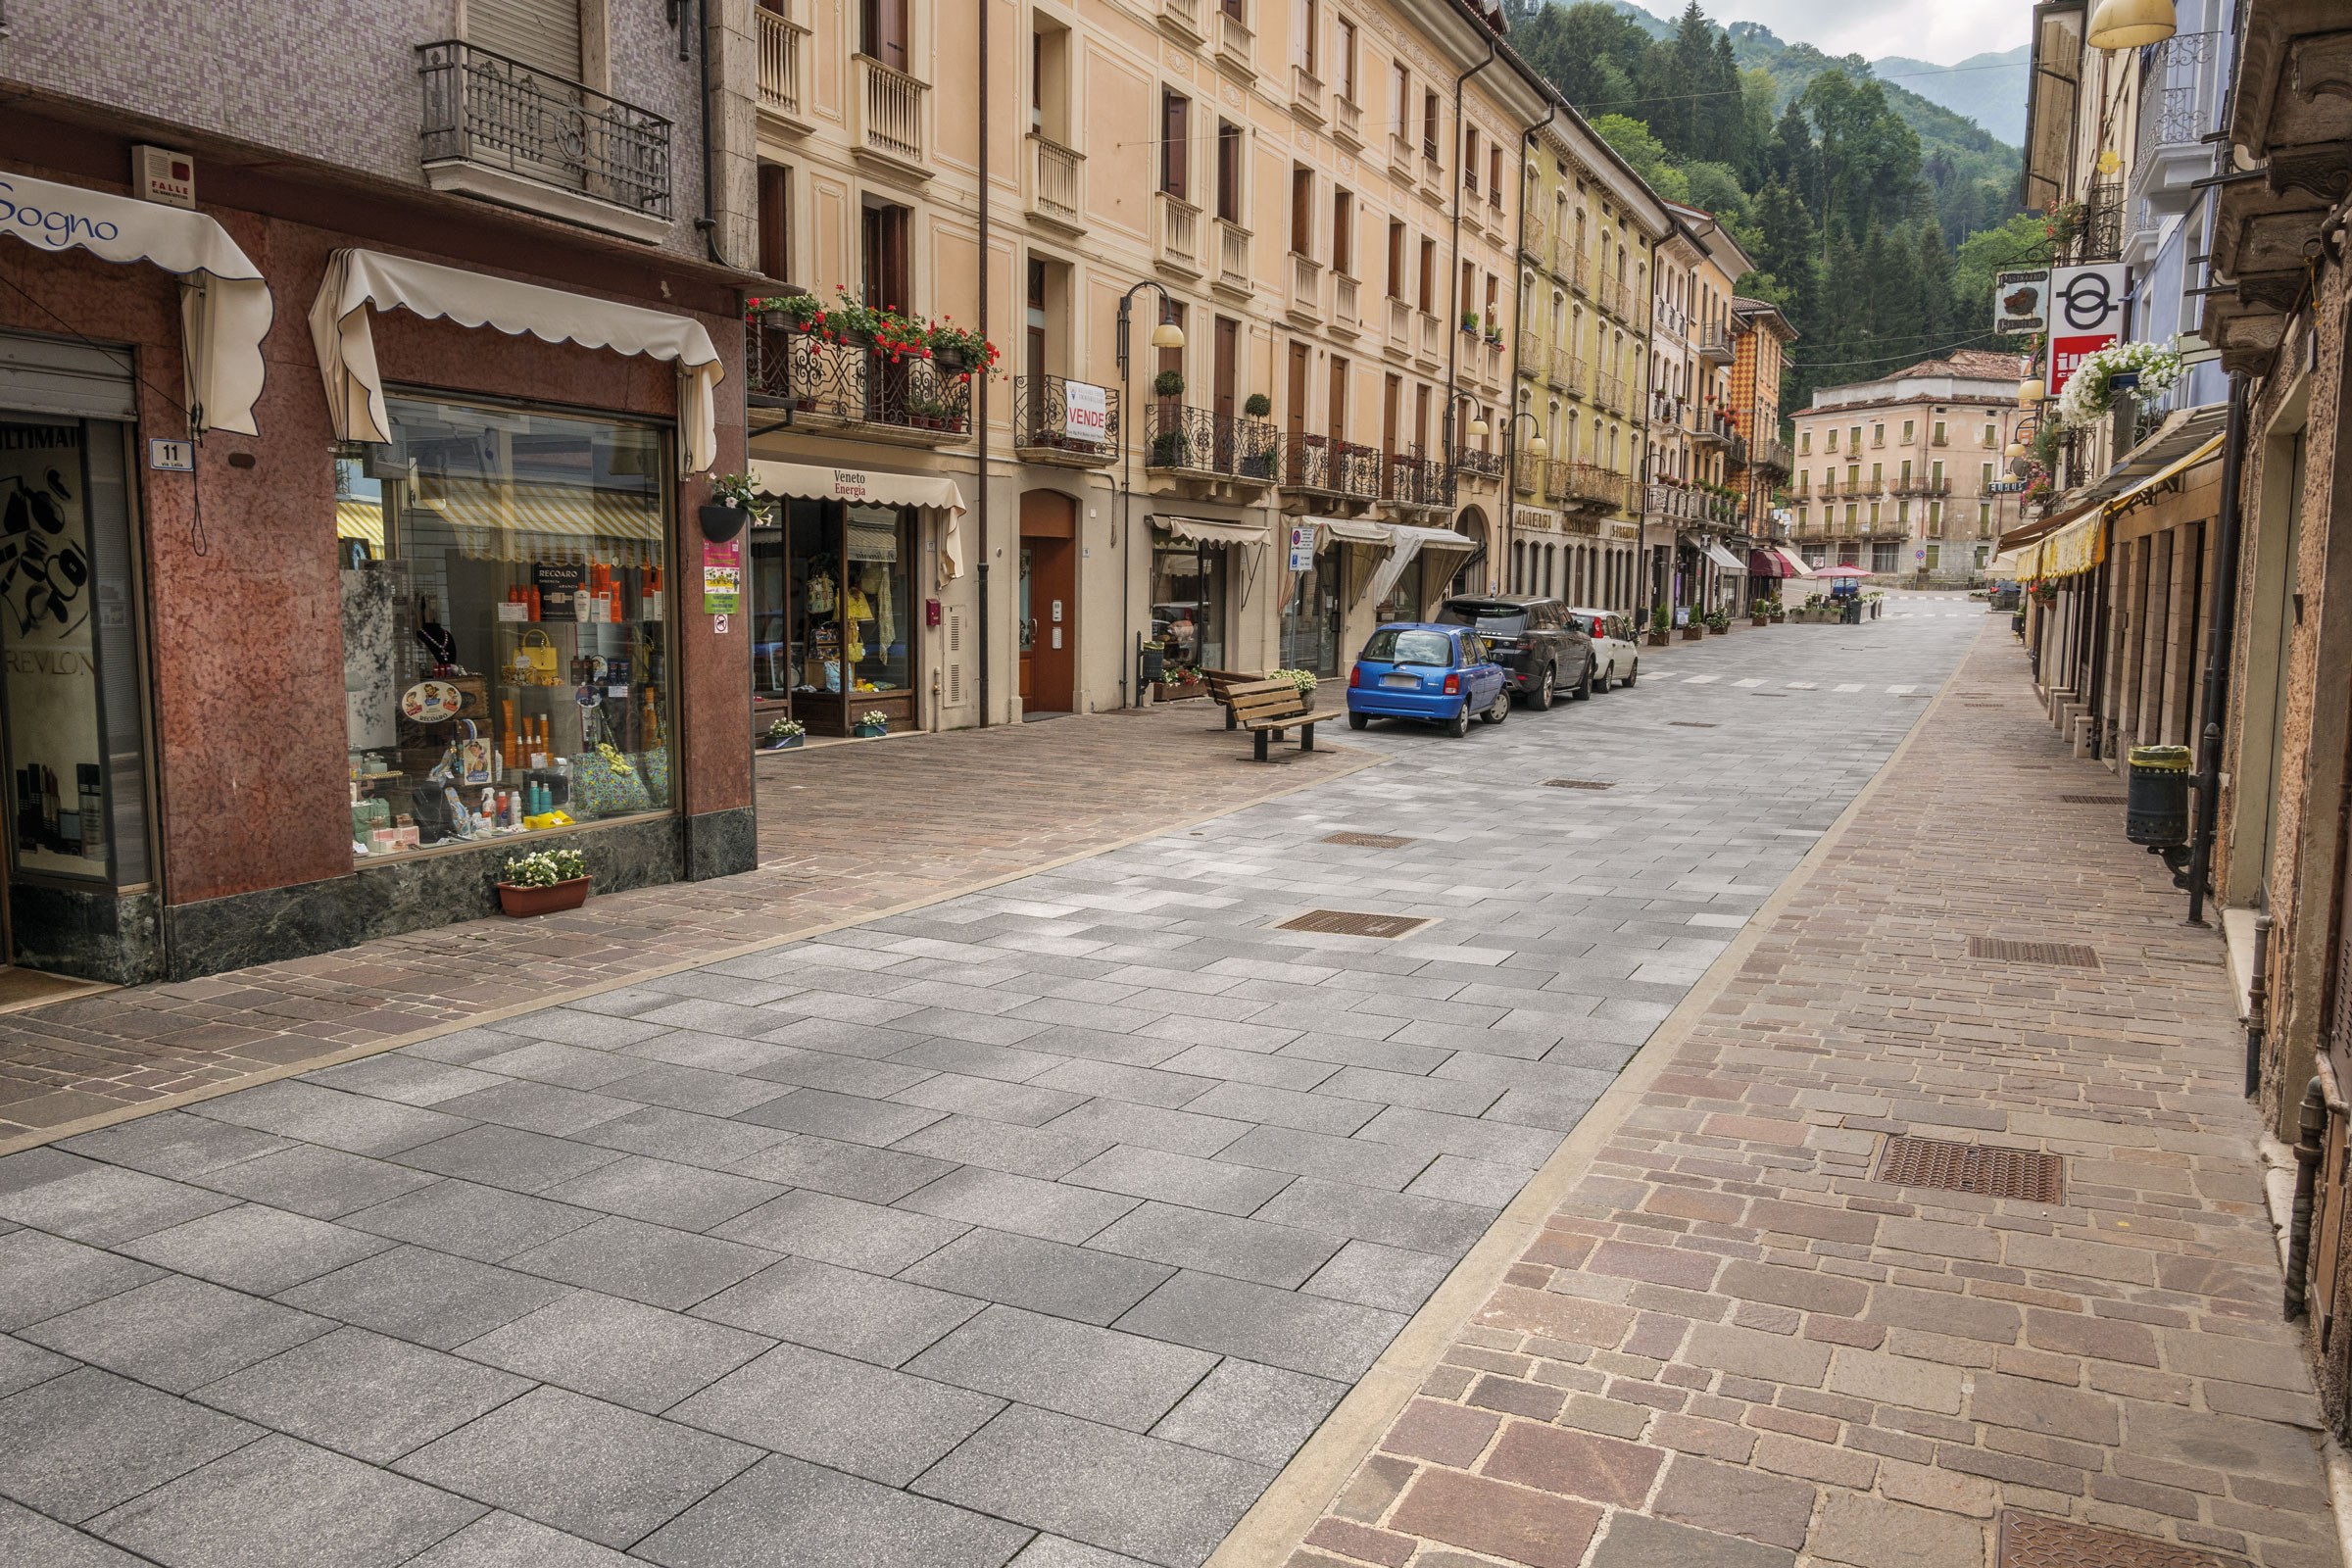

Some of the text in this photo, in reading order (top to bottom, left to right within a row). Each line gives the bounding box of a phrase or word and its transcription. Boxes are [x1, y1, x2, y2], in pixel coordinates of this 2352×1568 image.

[151, 180, 189, 195] FALLE
[1069, 407, 1104, 428] VENDE
[163, 444, 177, 461] 11
[834, 469, 865, 484] Veneto
[835, 482, 866, 499] Energia
[538, 569, 578, 578] RECOARO
[6, 650, 95, 676] REVLON
[418, 712, 449, 722] RECOARO
